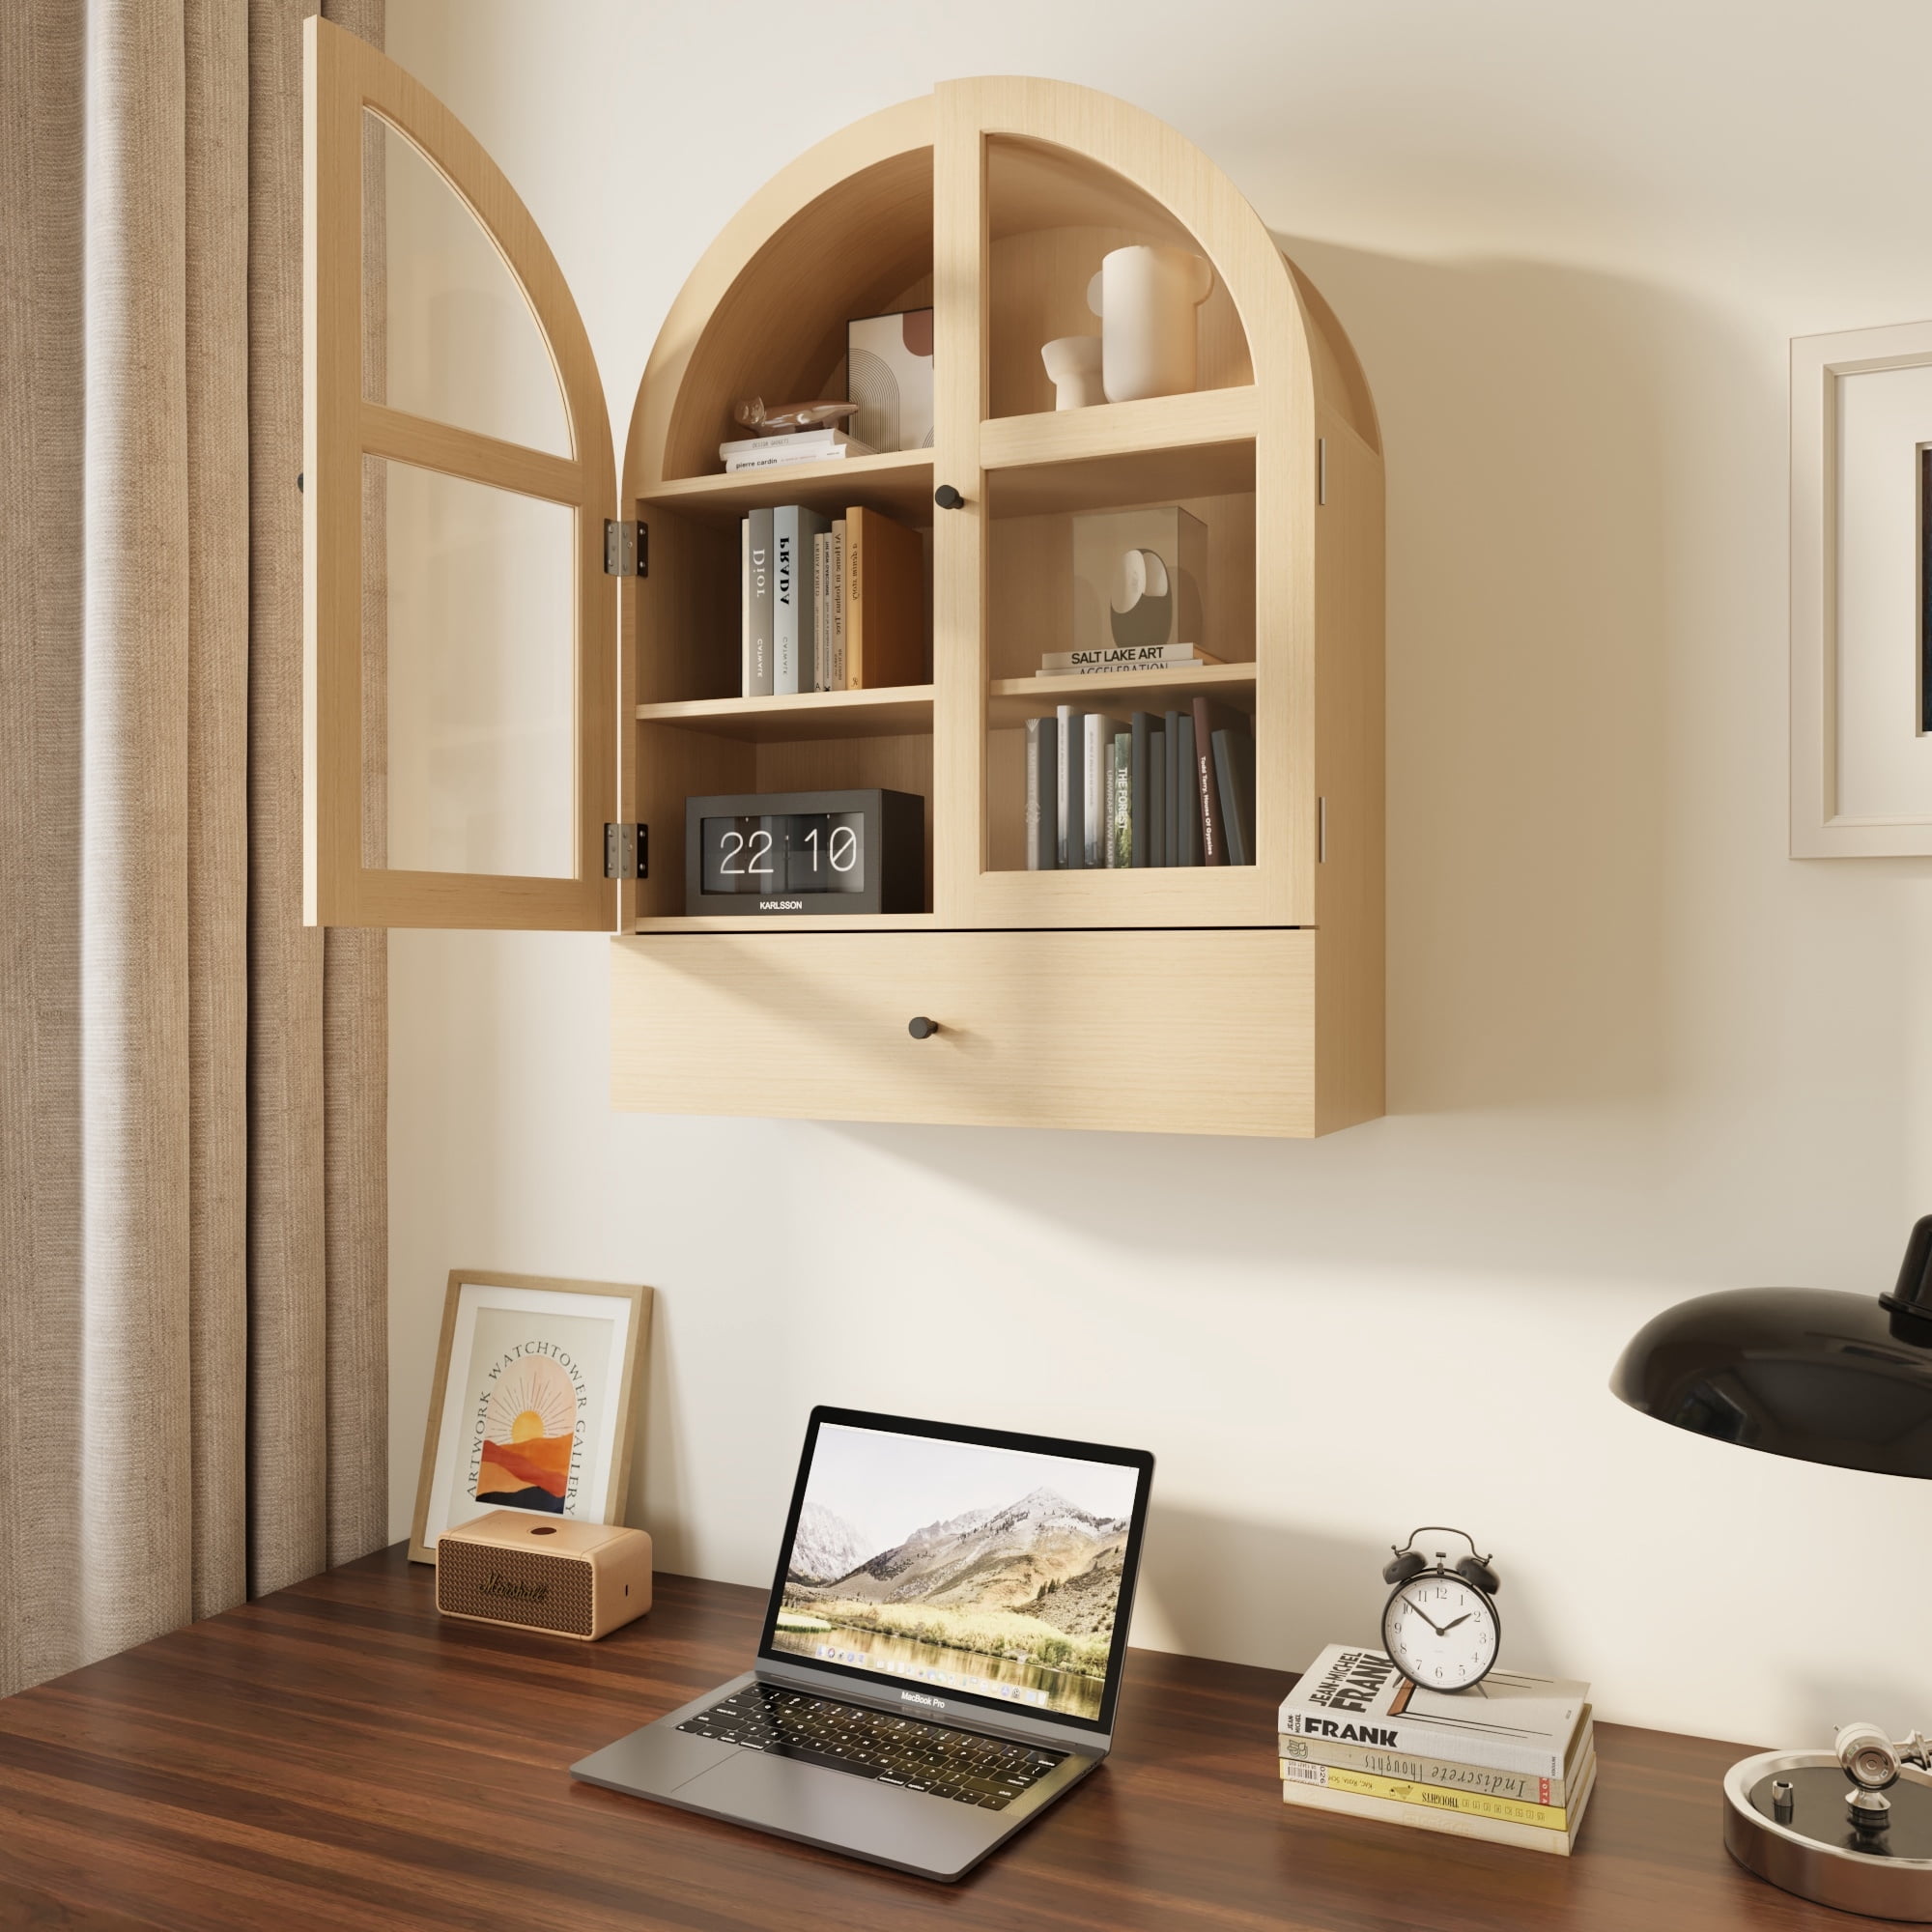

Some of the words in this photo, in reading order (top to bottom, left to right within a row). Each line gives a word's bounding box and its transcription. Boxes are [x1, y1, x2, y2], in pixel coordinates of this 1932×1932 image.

[735, 460, 755, 469] pierre
[756, 457, 778, 467] cardin
[1071, 651, 1102, 665] SALT
[1104, 648, 1136, 663] LAKE
[1138, 646, 1164, 660] ART
[1118, 767, 1128, 788] THE
[1118, 789, 1128, 829] FOREST
[1206, 817, 1211, 827] Of
[720, 830, 774, 874] 22
[804, 826, 857, 872] 10
[759, 901, 803, 910] KARLSSON
[467, 1391, 491, 1498] ARTWORK
[488, 1341, 587, 1408] WATCHTOWER
[565, 1419, 586, 1516] GALLERY
[478, 1571, 549, 1601] Marshall
[1418, 1590, 1428, 1603] 11
[1436, 1587, 1448, 1599] 12
[1460, 1594, 1463, 1606] 1
[1403, 1604, 1413, 1615] 10
[1473, 1611, 1481, 1623] 2
[1394, 1622, 1402, 1634] 9
[1479, 1633, 1487, 1644] 3
[1400, 1643, 1407, 1654] 8
[1471, 1652, 1479, 1662] 4
[1415, 1659, 1423, 1670] 7
[1459, 1664, 1465, 1676] 5
[1435, 1666, 1443, 1678] 6
[1308, 1652, 1363, 1707] JEAN-MICHEL
[1327, 1653, 1395, 1714] FRANK
[900, 1690, 932, 1706] MacBook
[932, 1698, 946, 1709] Pro
[1304, 1717, 1398, 1747] FRANK
[1364, 1754, 1423, 1782] Thoughts
[1432, 1766, 1527, 1798] Indiscrete
[1421, 1792, 1460, 1808] THOUGHTS
